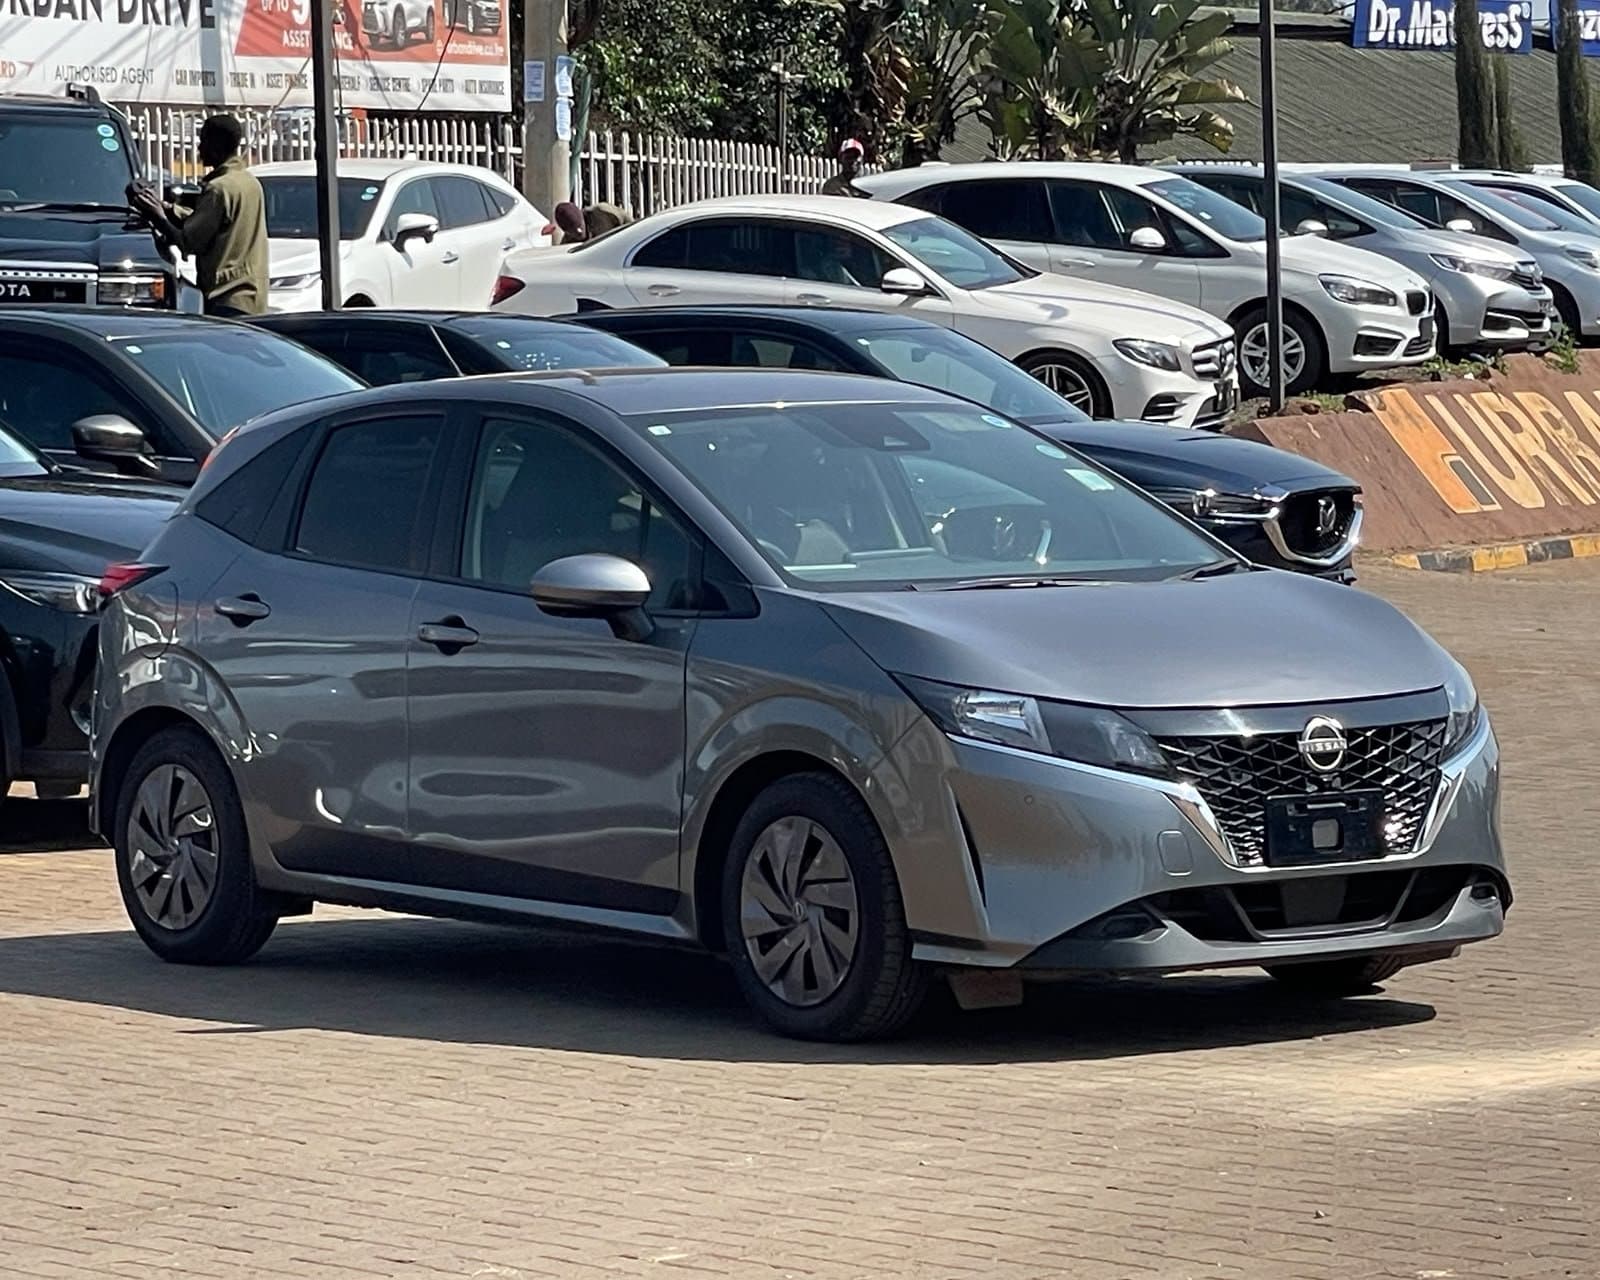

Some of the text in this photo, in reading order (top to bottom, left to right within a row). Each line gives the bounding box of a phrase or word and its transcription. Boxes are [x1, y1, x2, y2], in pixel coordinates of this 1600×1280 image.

[282, 30, 310, 48] ASSET
[55, 65, 154, 84] AUTHORISED AGENT
[1299, 740, 1347, 752] NISSAN
